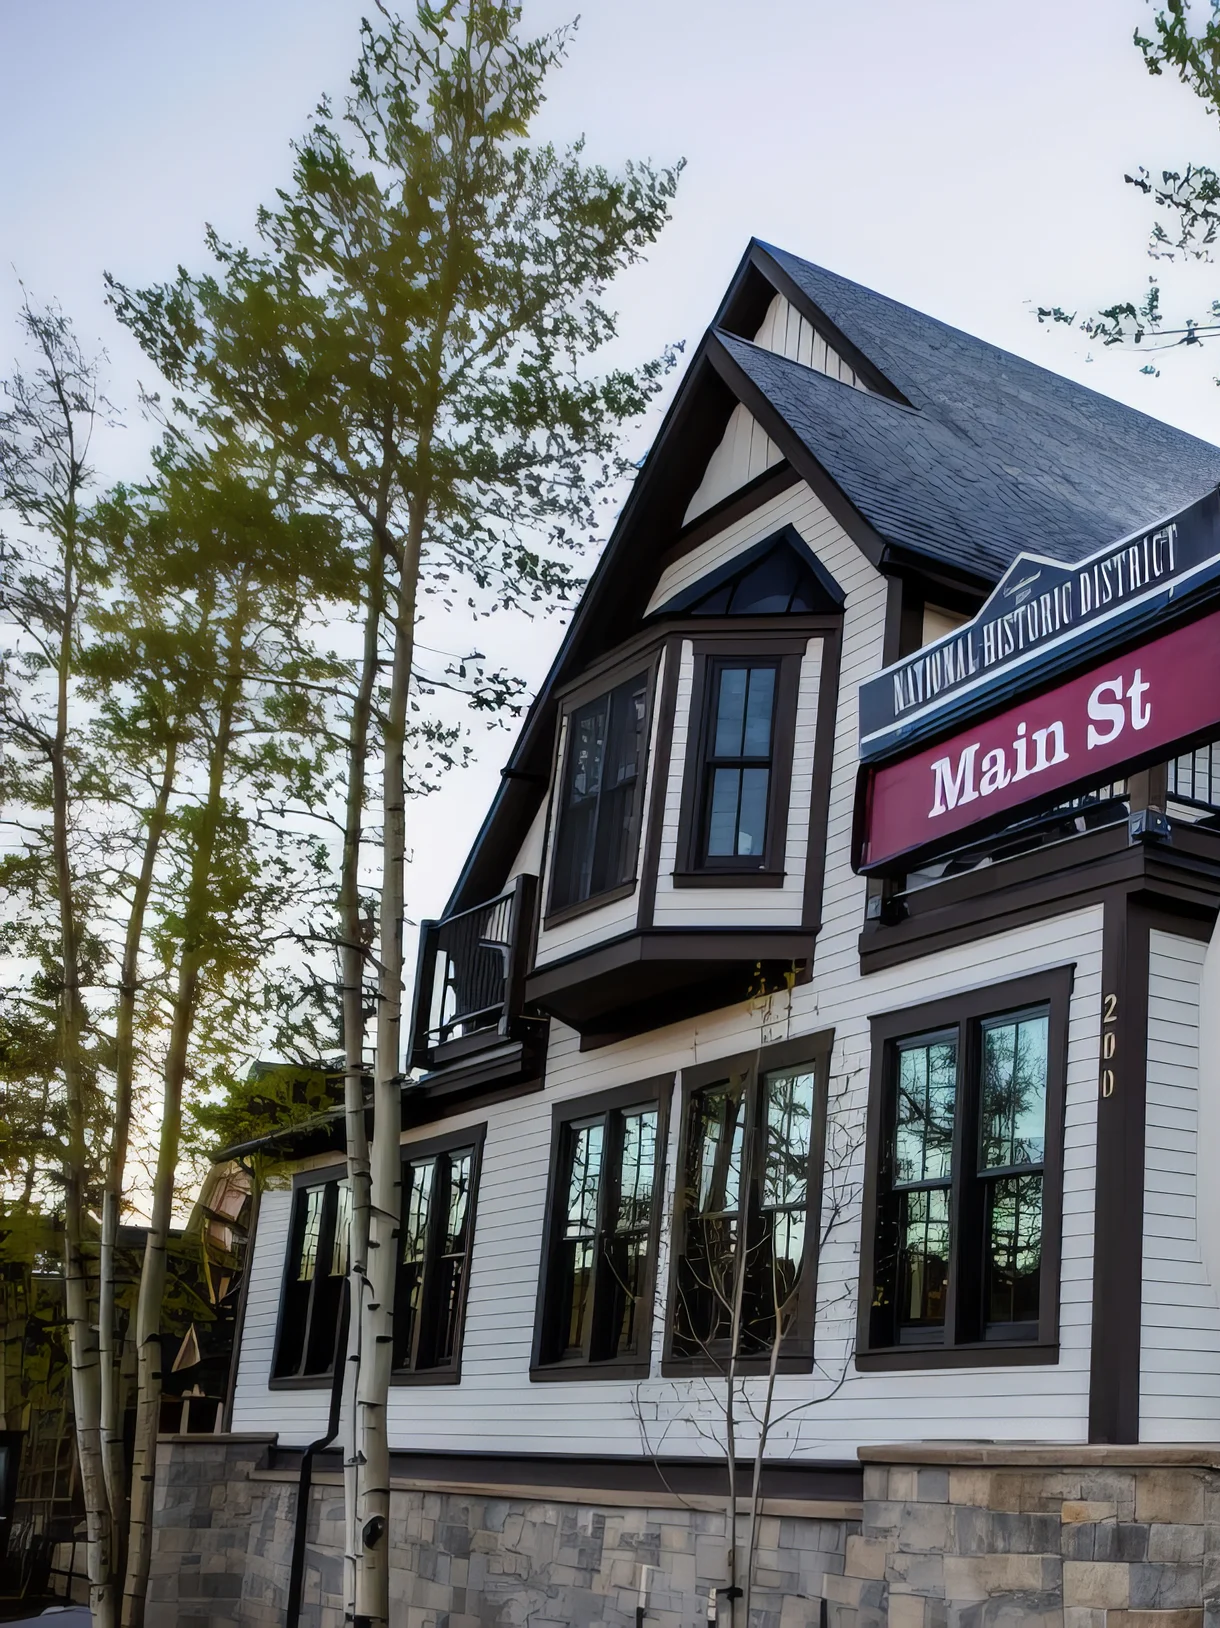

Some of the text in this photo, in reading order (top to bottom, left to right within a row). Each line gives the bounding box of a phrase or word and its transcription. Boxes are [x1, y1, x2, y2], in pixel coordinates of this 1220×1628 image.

[893, 523, 1178, 717] NATIONAL HISTORIC DISTRICT
[927, 667, 1152, 819] Main St
